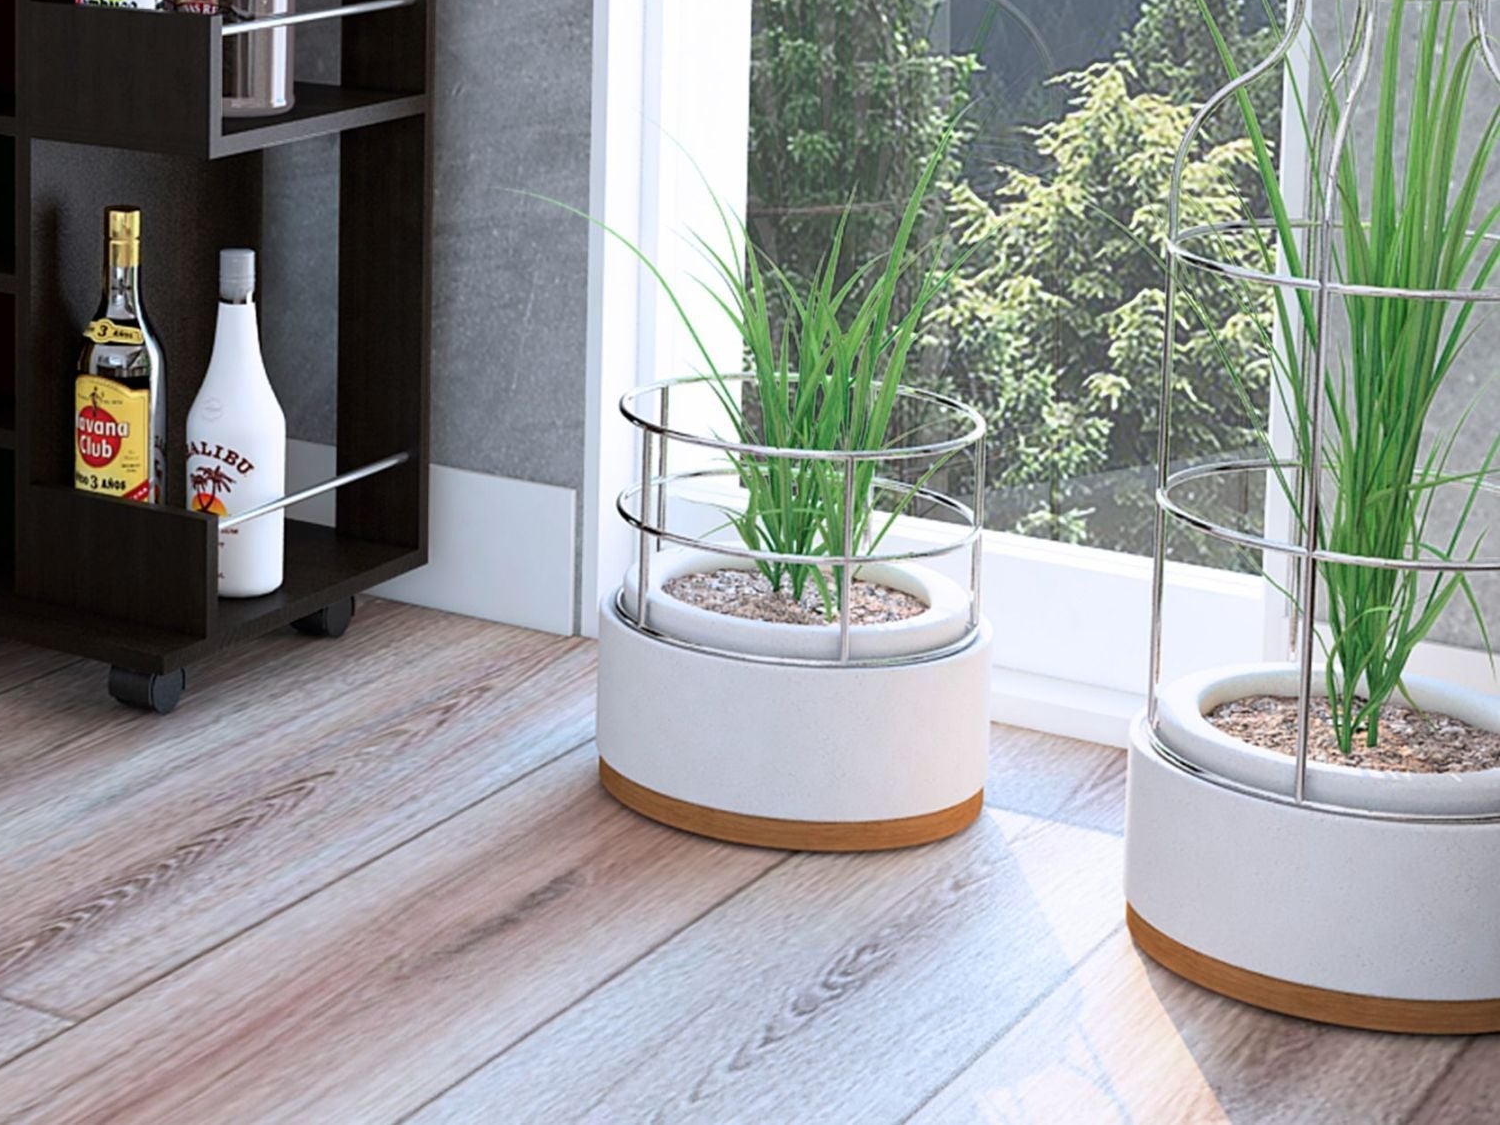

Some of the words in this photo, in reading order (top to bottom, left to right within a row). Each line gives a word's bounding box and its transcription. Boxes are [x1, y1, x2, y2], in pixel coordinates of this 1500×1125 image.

[97, 325, 108, 337] 3
[79, 435, 113, 458] Club
[90, 474, 99, 489] 3
[101, 477, 126, 490] AÑOS
